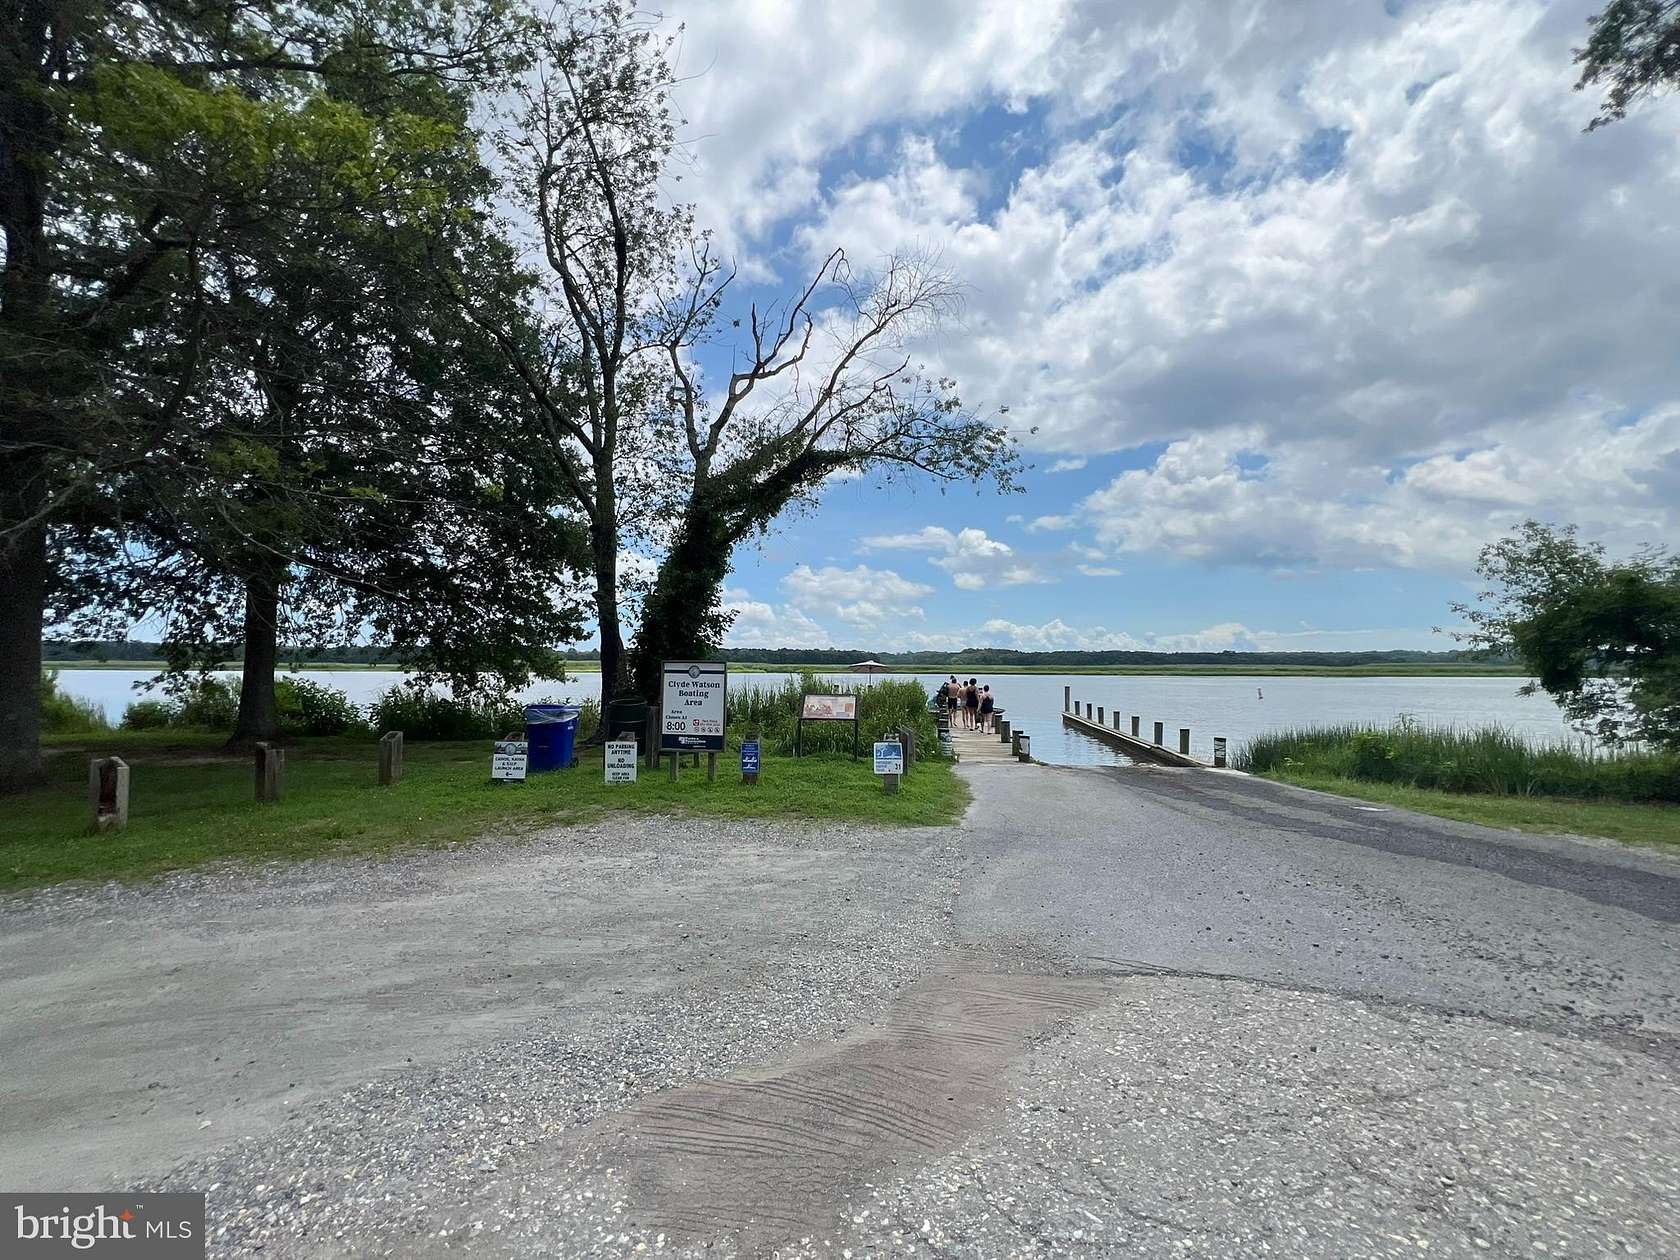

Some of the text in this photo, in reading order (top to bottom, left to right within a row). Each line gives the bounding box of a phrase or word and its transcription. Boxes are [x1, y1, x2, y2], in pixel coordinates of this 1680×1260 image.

[668, 680, 690, 689] Clyde
[678, 690, 709, 699] Boating
[666, 721, 686, 730] 8:00
